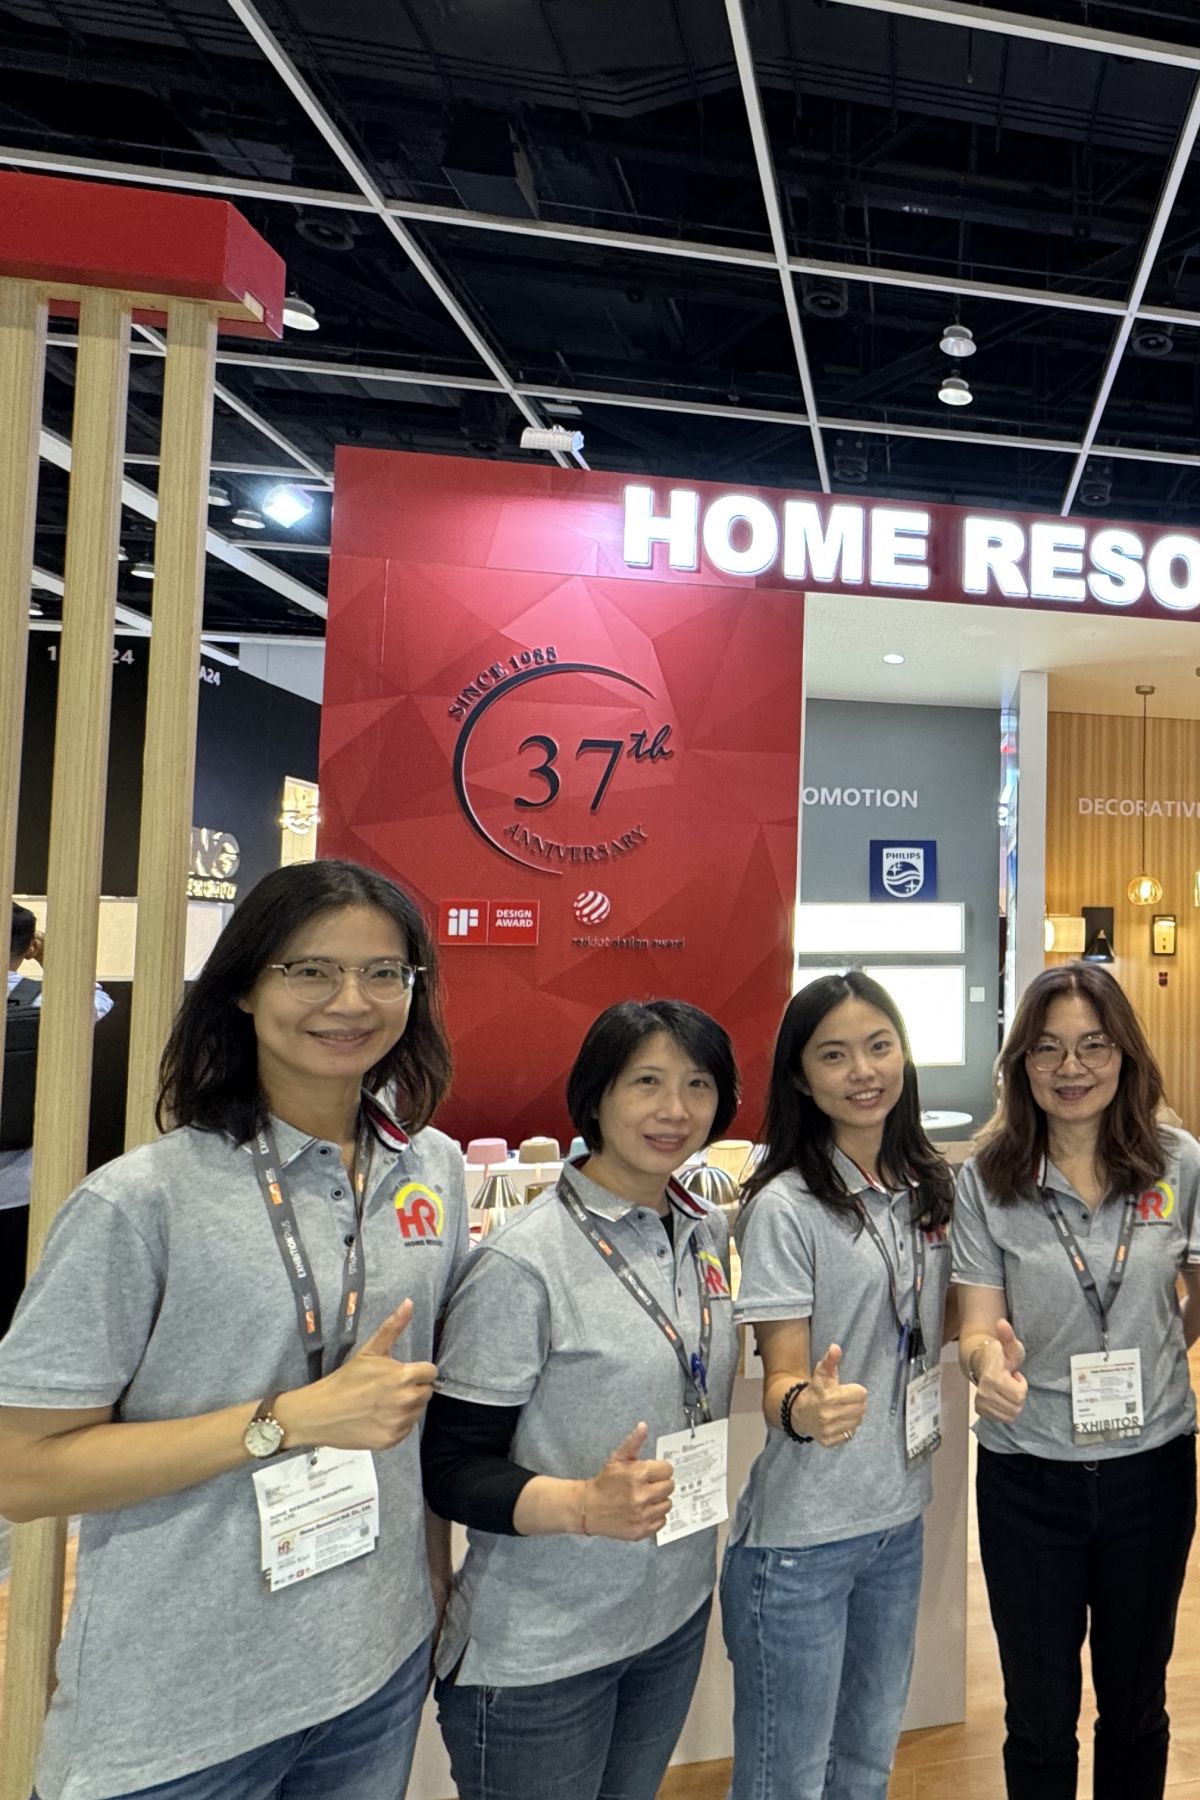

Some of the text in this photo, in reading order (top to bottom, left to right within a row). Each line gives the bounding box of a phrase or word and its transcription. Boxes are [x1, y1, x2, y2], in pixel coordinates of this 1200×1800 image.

[621, 484, 931, 592] HOME
[448, 645, 558, 721] SINCE 1988
[513, 724, 674, 816] 37th
[802, 787, 919, 809] OMOTION
[504, 822, 648, 863] ANNIVERSARY
[885, 851, 921, 861] PHILIPS
[495, 909, 532, 919] DESIGN
[495, 918, 534, 928] AWARD
[396, 1198, 437, 1238] HR
[1073, 1415, 1140, 1434] EXHIBITOR
